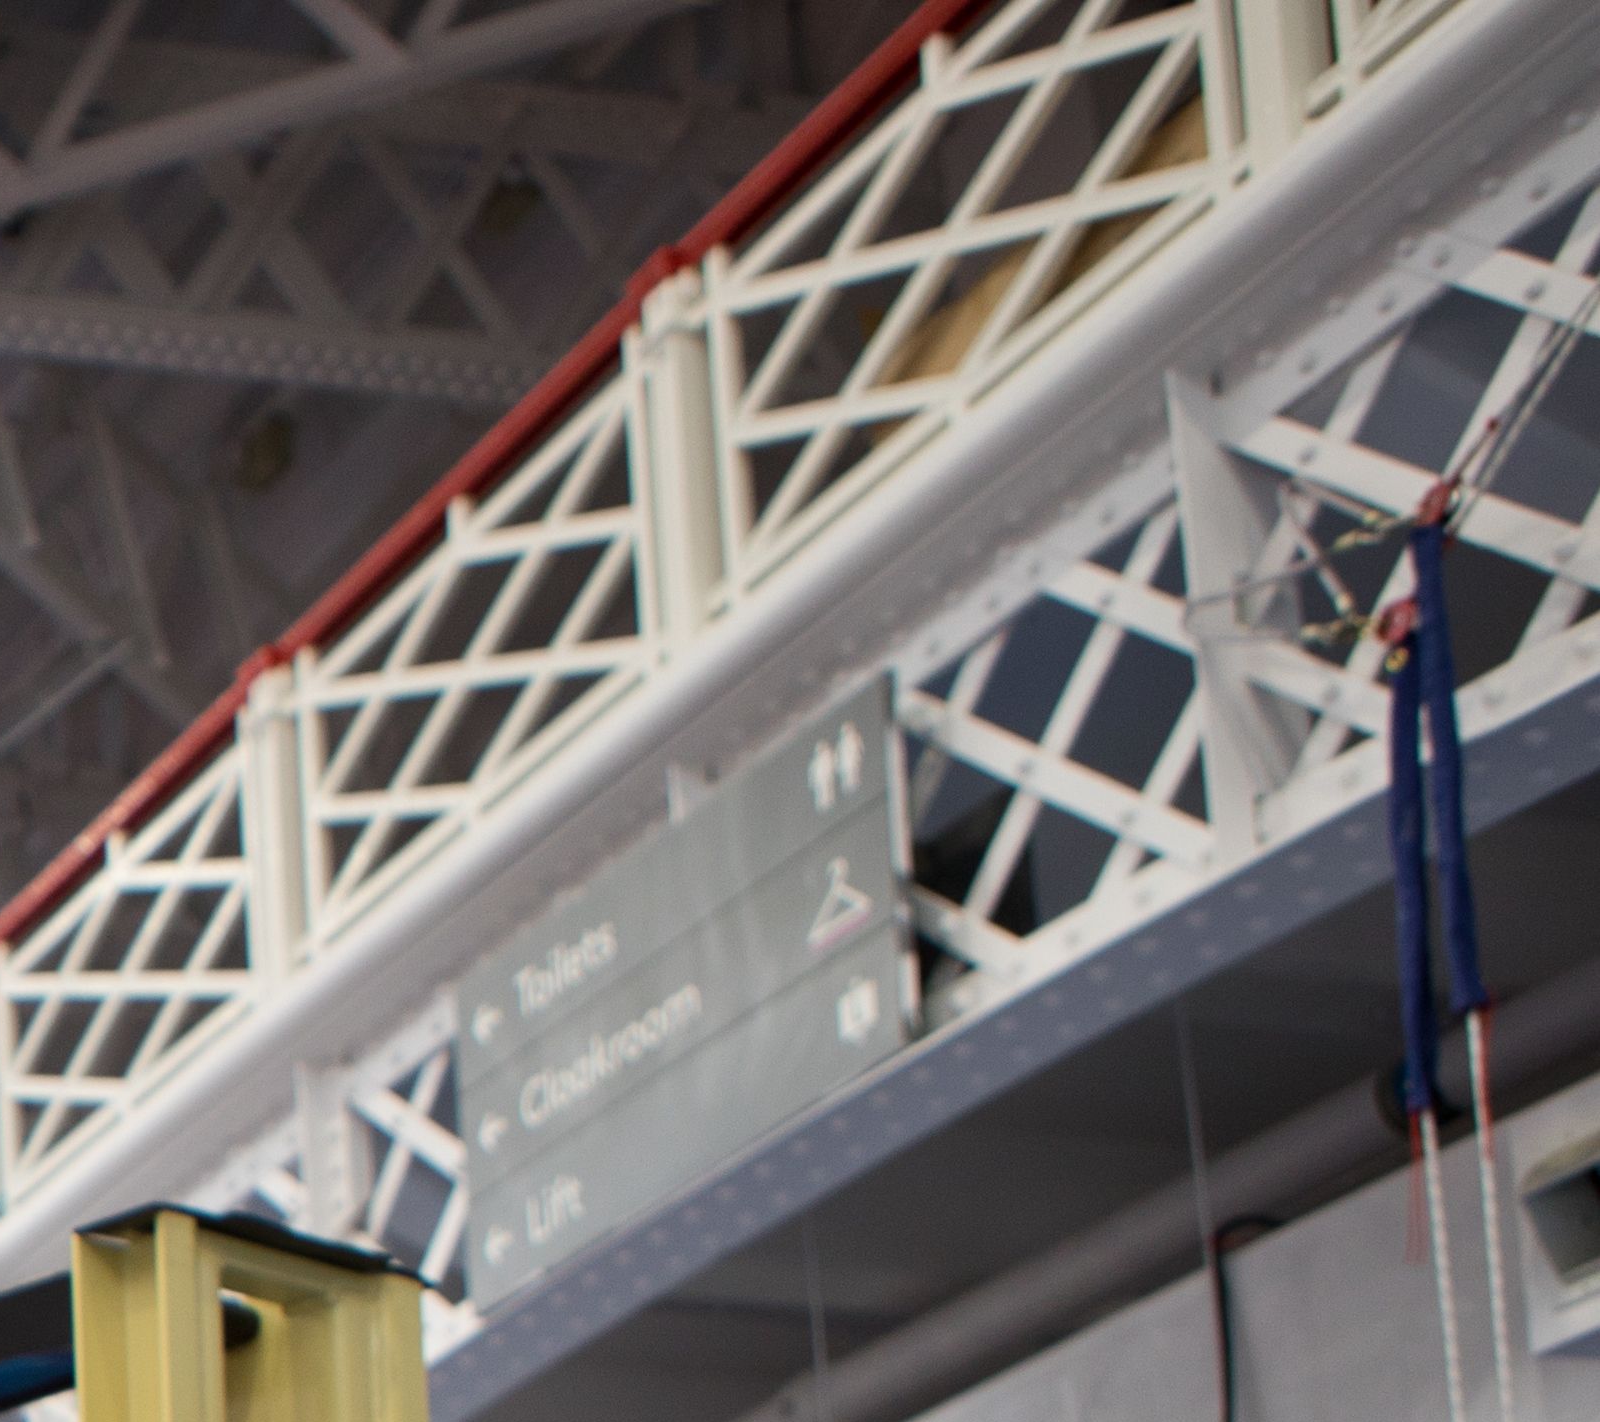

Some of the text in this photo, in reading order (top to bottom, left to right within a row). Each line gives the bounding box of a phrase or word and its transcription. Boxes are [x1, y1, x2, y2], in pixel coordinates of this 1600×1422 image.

[514, 920, 618, 1018] Toilets
[518, 982, 703, 1130] Cloakroom
[524, 1174, 583, 1244] Lift
